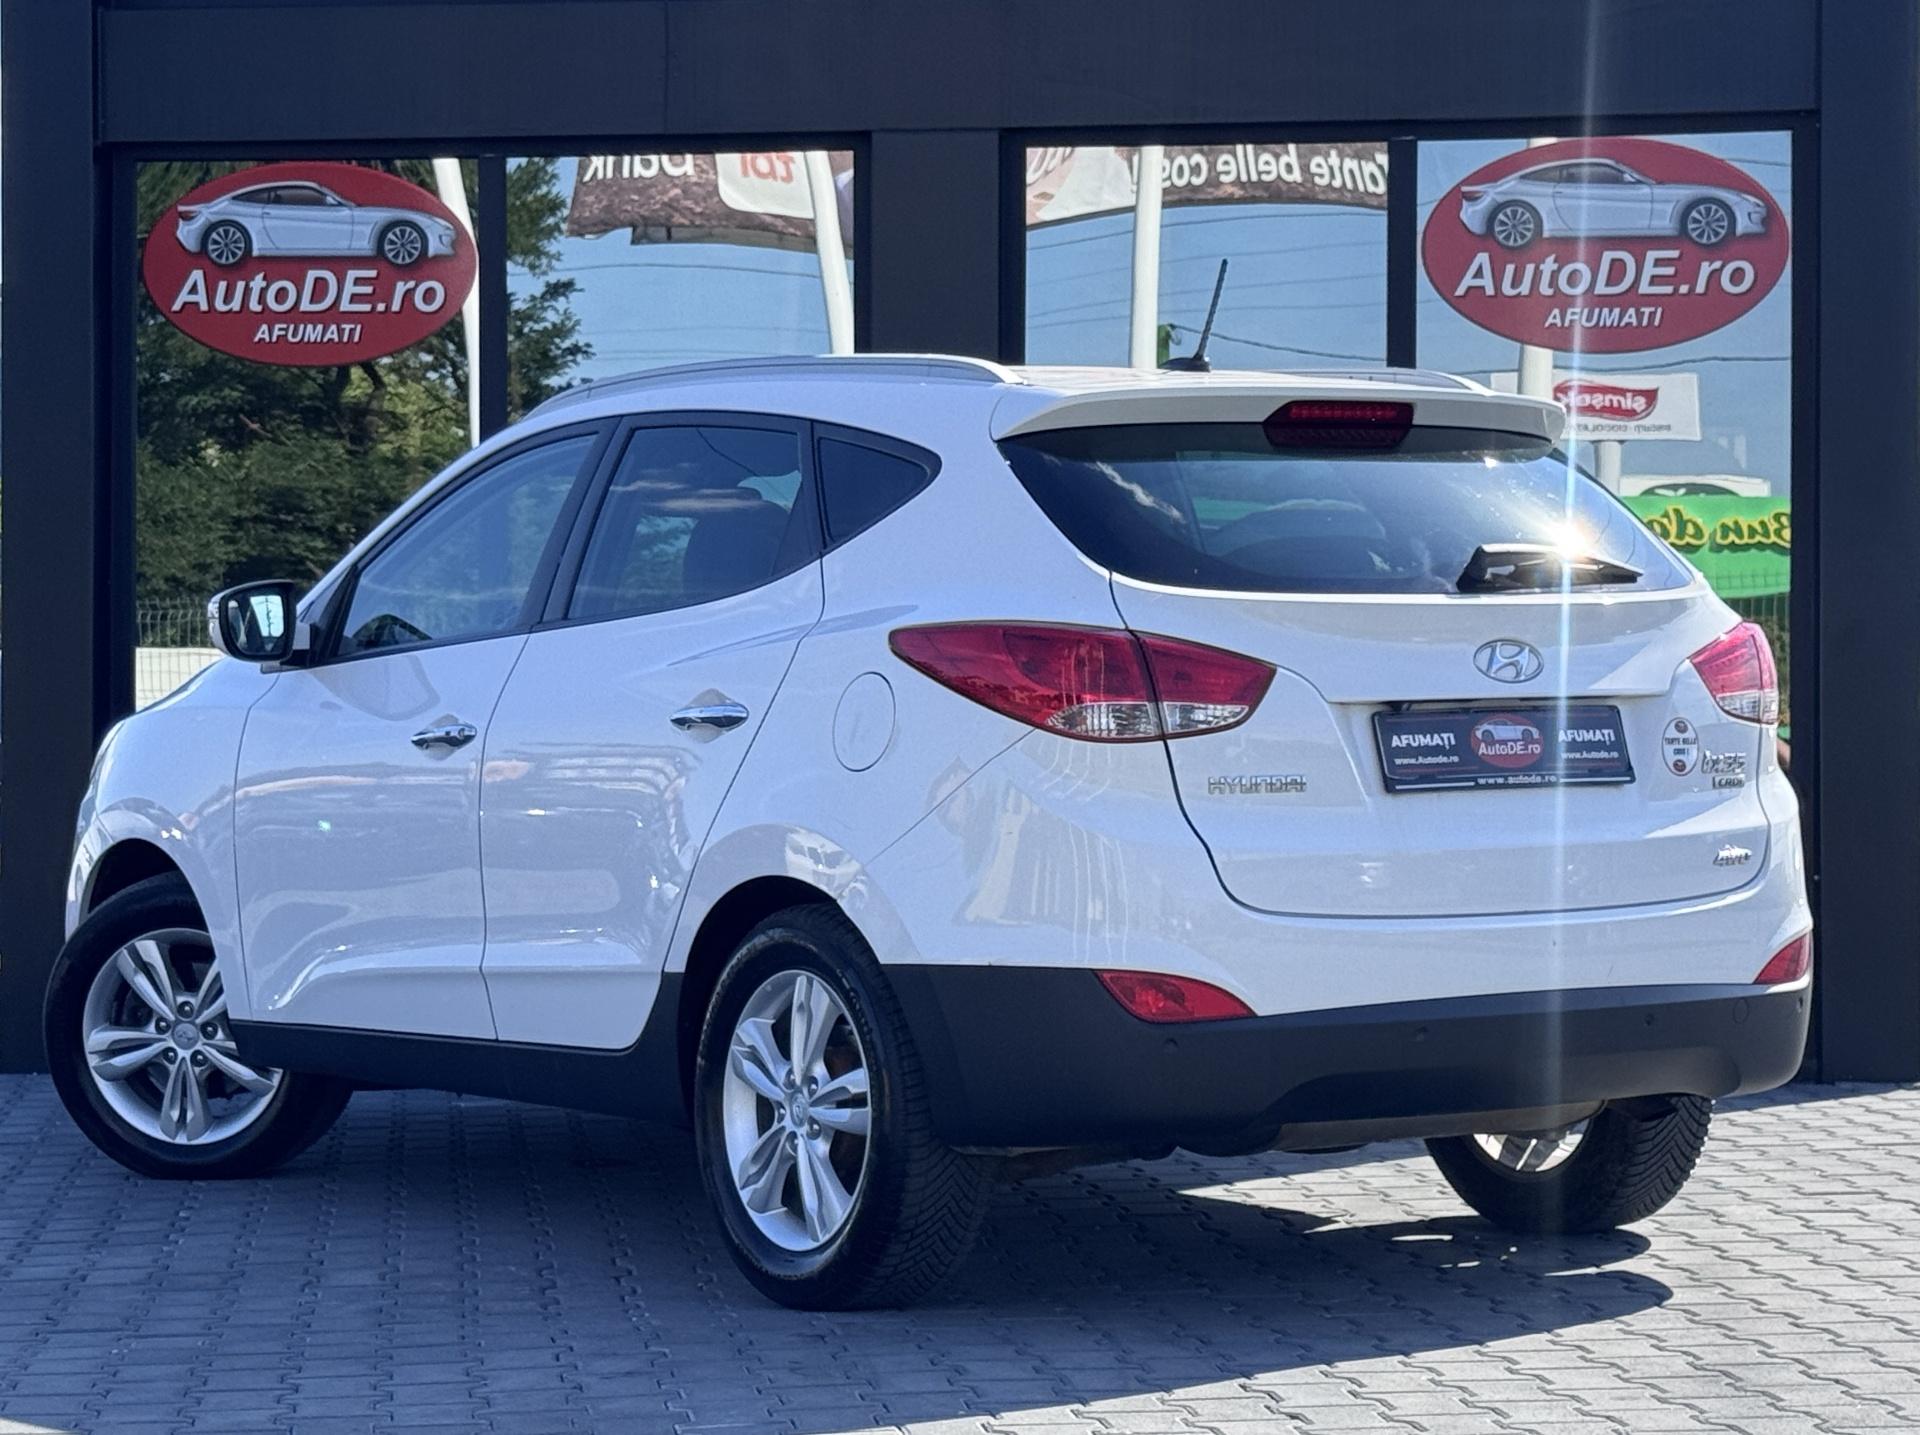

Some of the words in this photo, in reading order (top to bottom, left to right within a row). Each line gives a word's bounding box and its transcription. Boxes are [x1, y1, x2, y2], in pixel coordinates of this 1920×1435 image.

[1453, 250, 1756, 296] AutoDE.ro
[171, 269, 446, 312] AutoDE.ro
[1544, 306, 1663, 328] AFUMATI
[253, 323, 363, 343] AFUMATI
[1478, 741, 1541, 756] AutoDE.ro
[1207, 775, 1307, 795] HYUNDAI
